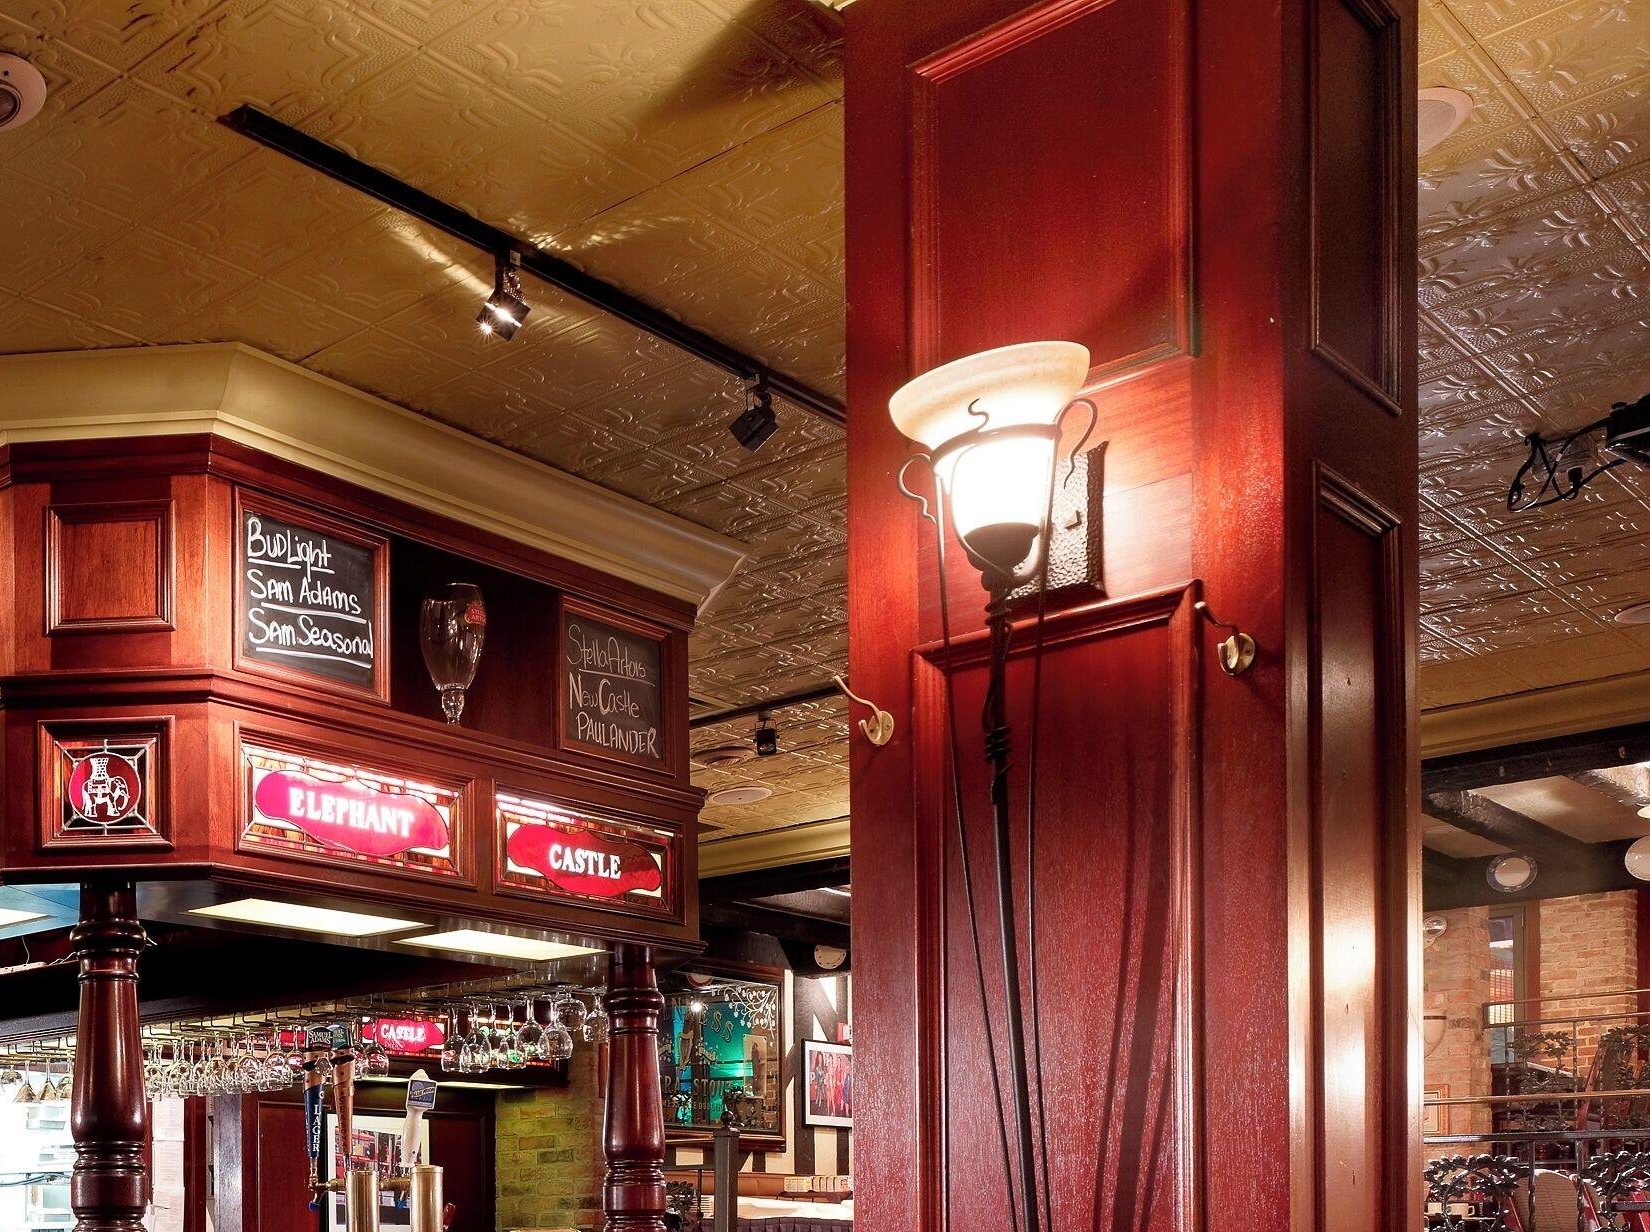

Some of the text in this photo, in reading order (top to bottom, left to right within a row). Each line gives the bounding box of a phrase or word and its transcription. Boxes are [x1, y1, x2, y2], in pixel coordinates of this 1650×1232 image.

[298, 615, 374, 659] Seasonal
[576, 711, 659, 759] PAULANDER
[289, 787, 415, 838] ELEPHANT
[549, 843, 622, 880] CASTLE
[308, 1030, 333, 1039] SAMUEL
[310, 1036, 331, 1044] ADAMS
[312, 1104, 321, 1152] LAGER
